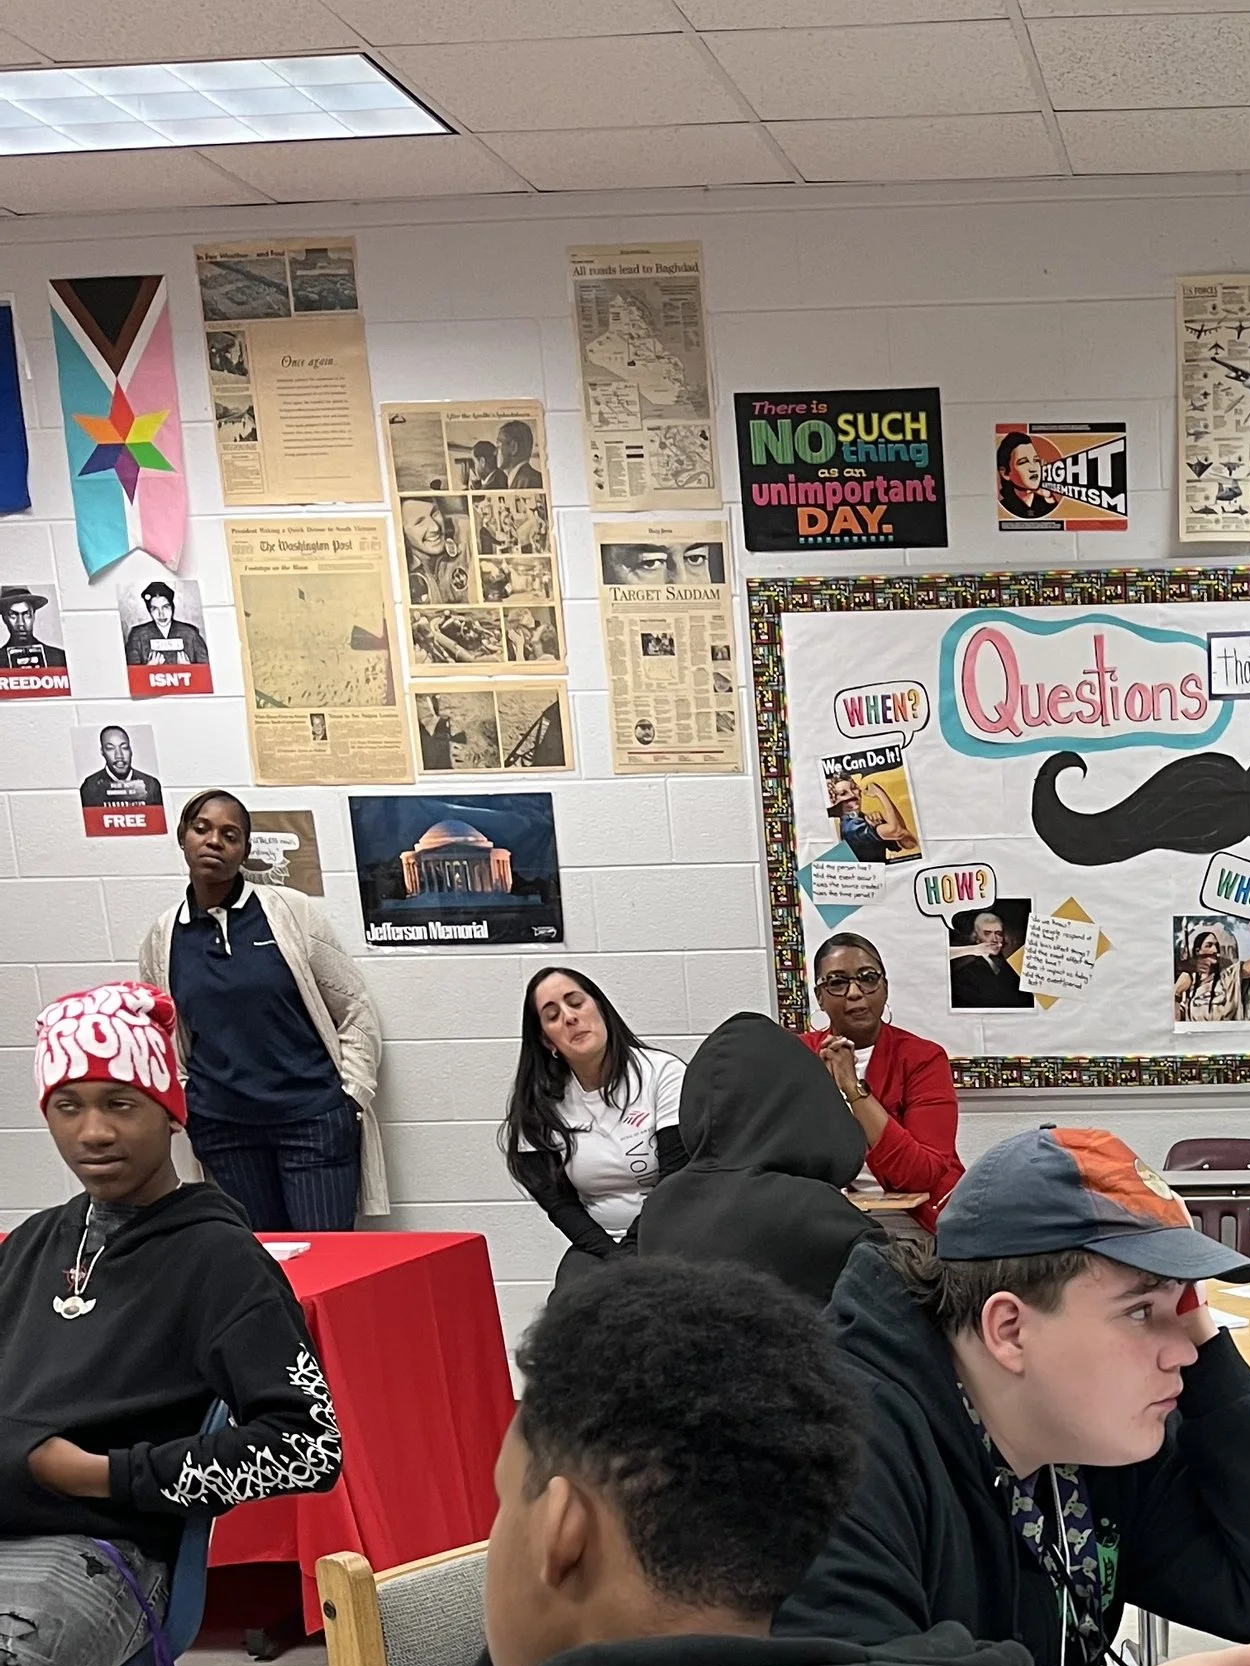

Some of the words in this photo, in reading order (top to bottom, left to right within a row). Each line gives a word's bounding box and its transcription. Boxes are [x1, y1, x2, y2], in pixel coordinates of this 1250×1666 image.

[573, 267, 585, 276] All
[589, 266, 616, 275] roads
[619, 265, 639, 274] lead
[643, 265, 652, 273] to
[656, 263, 699, 275] Baghdad
[281, 355, 304, 368] Once
[752, 402, 807, 415] There
[810, 400, 827, 413] is
[749, 418, 836, 466] NO
[837, 412, 928, 442] SUCH
[842, 440, 929, 467] thing
[1042, 439, 1124, 488] FIGHT
[818, 468, 839, 478] as
[843, 467, 866, 477] an
[752, 474, 937, 510] unimportant
[796, 506, 893, 536] DAY.
[260, 541, 275, 552] The
[278, 540, 329, 553] Washington
[333, 540, 352, 553] Post
[609, 587, 662, 601] TARGET
[666, 586, 720, 600] SADDAM
[0, 675, 68, 690] REEDOM
[149, 673, 191, 687] ISN'T
[961, 627, 1207, 738] Questions
[843, 689, 920, 728] WHEN?
[821, 756, 842, 776] We
[843, 752, 866, 770] Can
[869, 751, 884, 766] Do
[886, 747, 900, 763] It!
[102, 814, 146, 828] FREE
[924, 870, 988, 905] HOW?
[365, 921, 427, 941] Jefferson
[429, 920, 488, 939] Memorial
